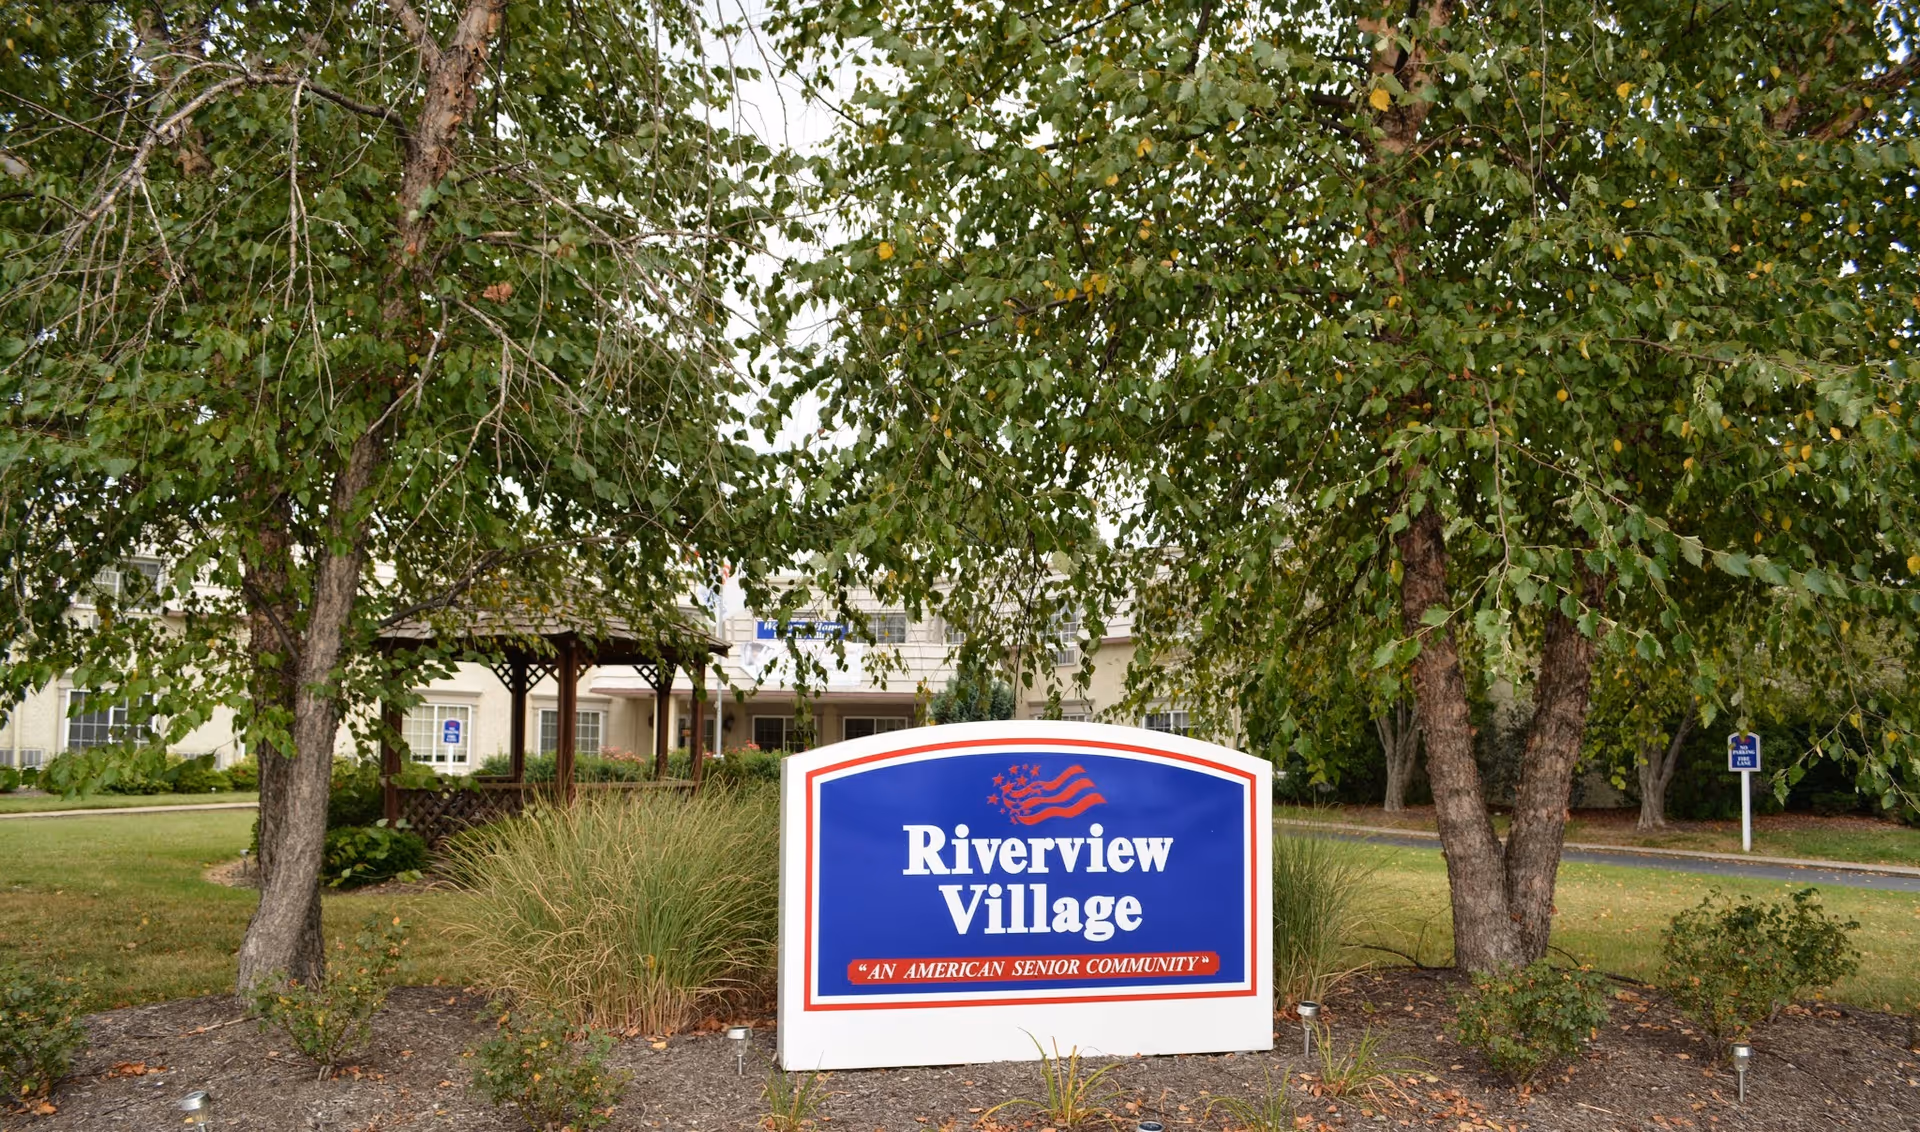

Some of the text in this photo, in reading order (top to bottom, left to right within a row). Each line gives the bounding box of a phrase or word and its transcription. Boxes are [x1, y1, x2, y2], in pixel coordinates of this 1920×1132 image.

[902, 823, 1174, 876] Riverview
[938, 883, 1143, 942] Village
[903, 961, 1005, 979] AMERICAN
[1011, 959, 1080, 977] SENIOR
